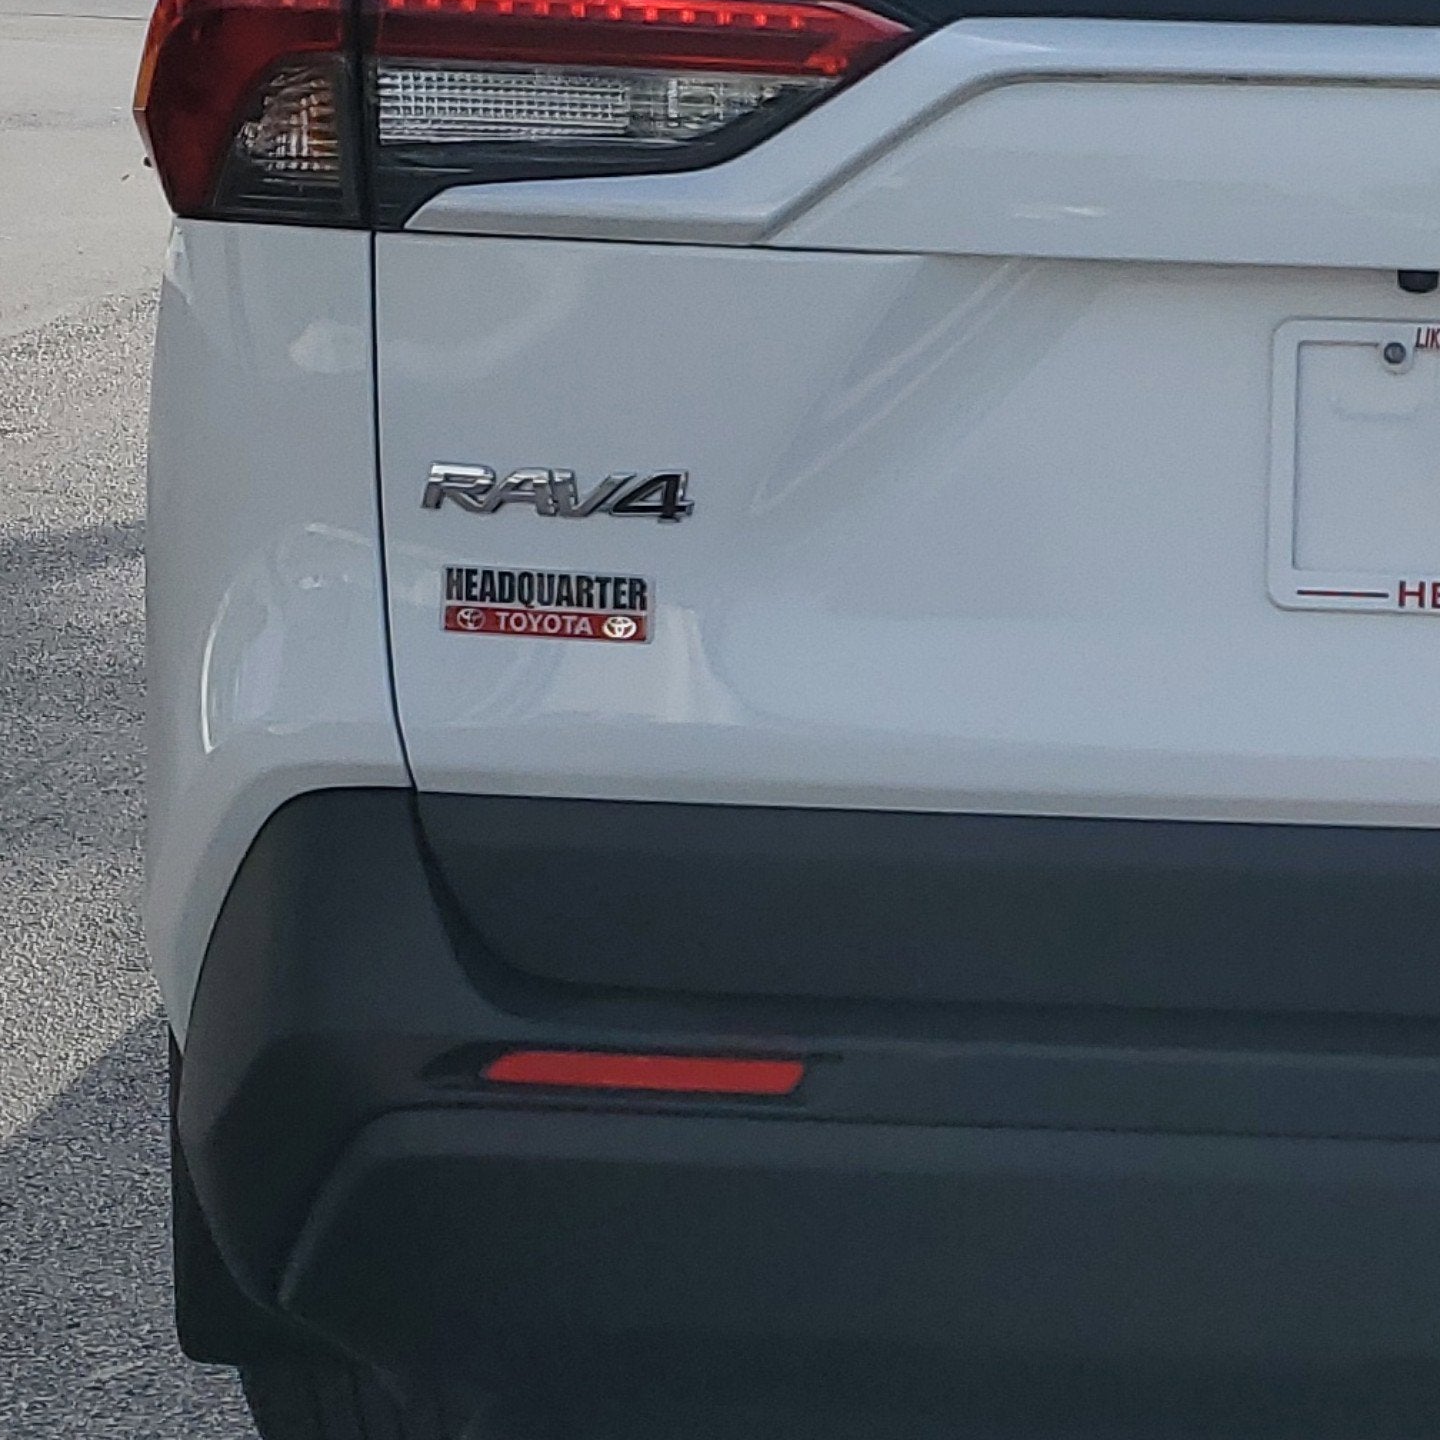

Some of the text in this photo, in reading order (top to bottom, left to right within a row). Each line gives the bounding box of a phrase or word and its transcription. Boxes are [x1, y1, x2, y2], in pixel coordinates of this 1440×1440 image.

[421, 461, 695, 523] RAV4
[445, 566, 648, 611] HEADQUARTER
[495, 611, 594, 635] TOYOTA
